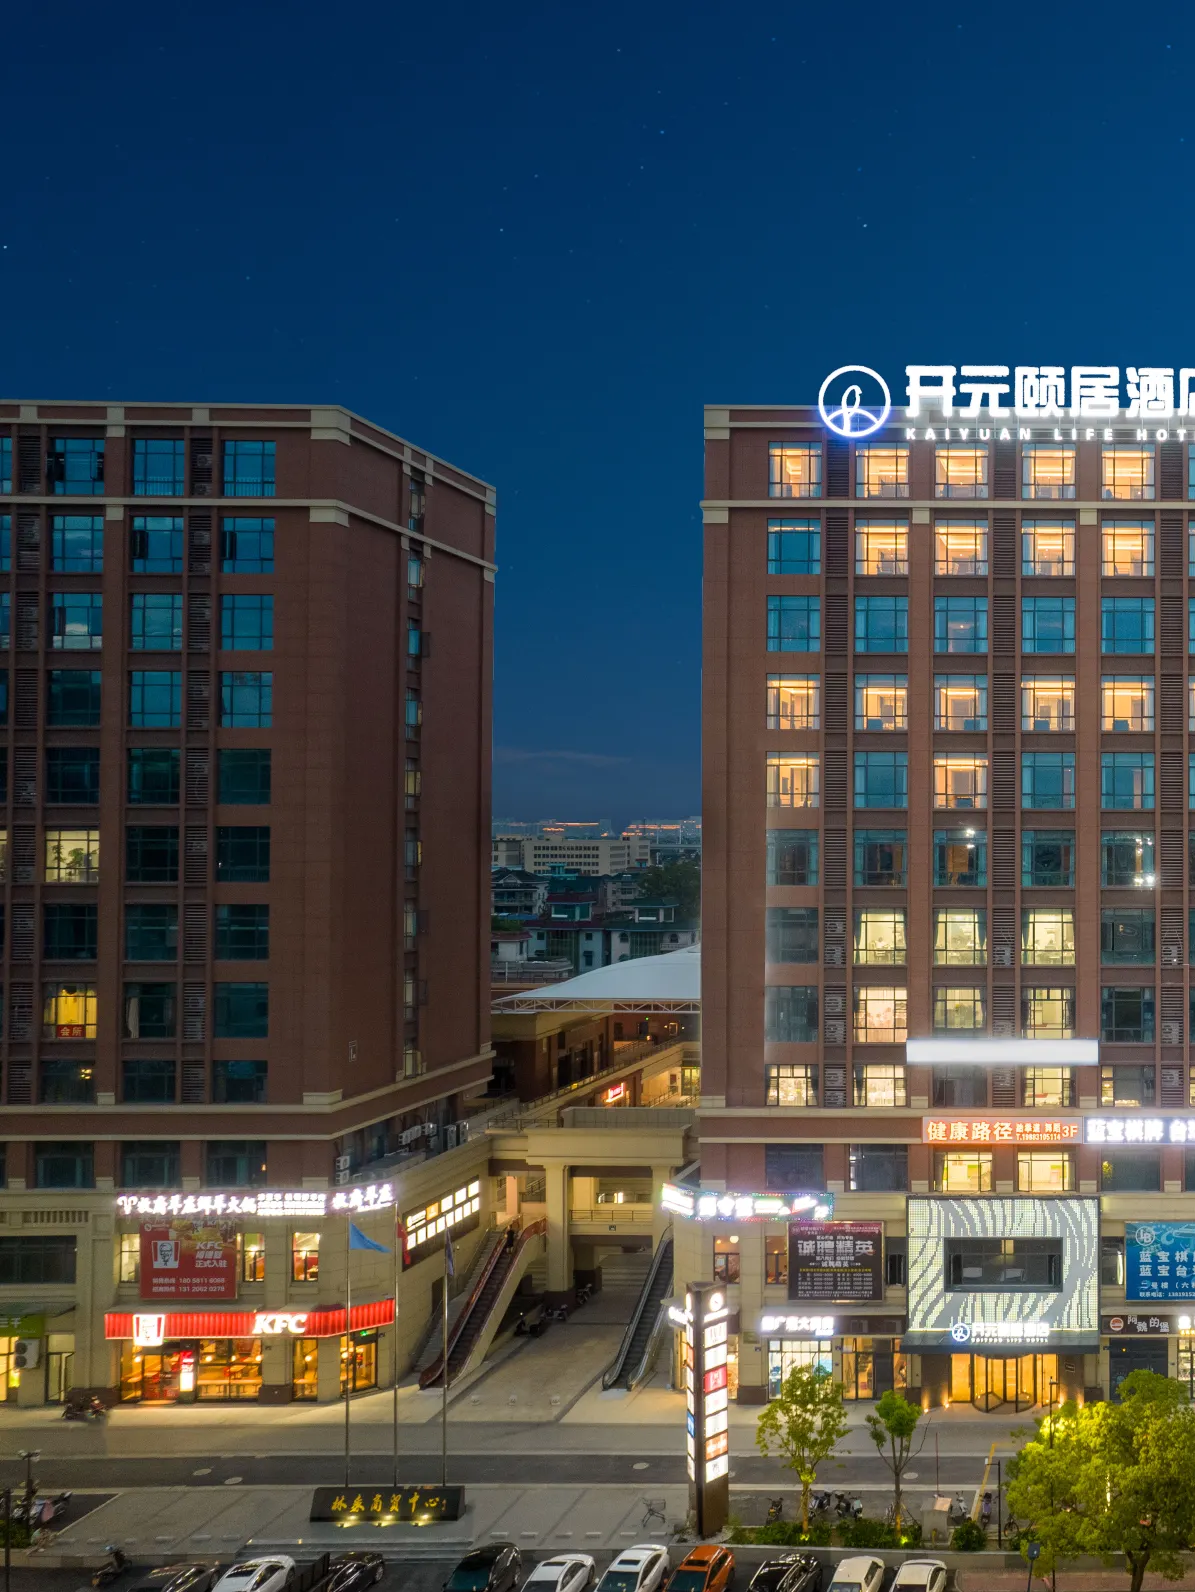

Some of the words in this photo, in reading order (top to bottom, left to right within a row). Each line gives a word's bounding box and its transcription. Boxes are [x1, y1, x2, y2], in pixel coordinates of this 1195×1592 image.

[906, 427, 1032, 440] KAIYUAN
[1054, 428, 1114, 441] LIFE
[927, 1121, 1013, 1141] 健康路径
[1062, 1125, 1078, 1138] 3F
[195, 1241, 224, 1249] KFC
[798, 1240, 874, 1256] 诚聘精英
[195, 1260, 228, 1268] 正式入驻
[252, 1313, 308, 1334] KFC
